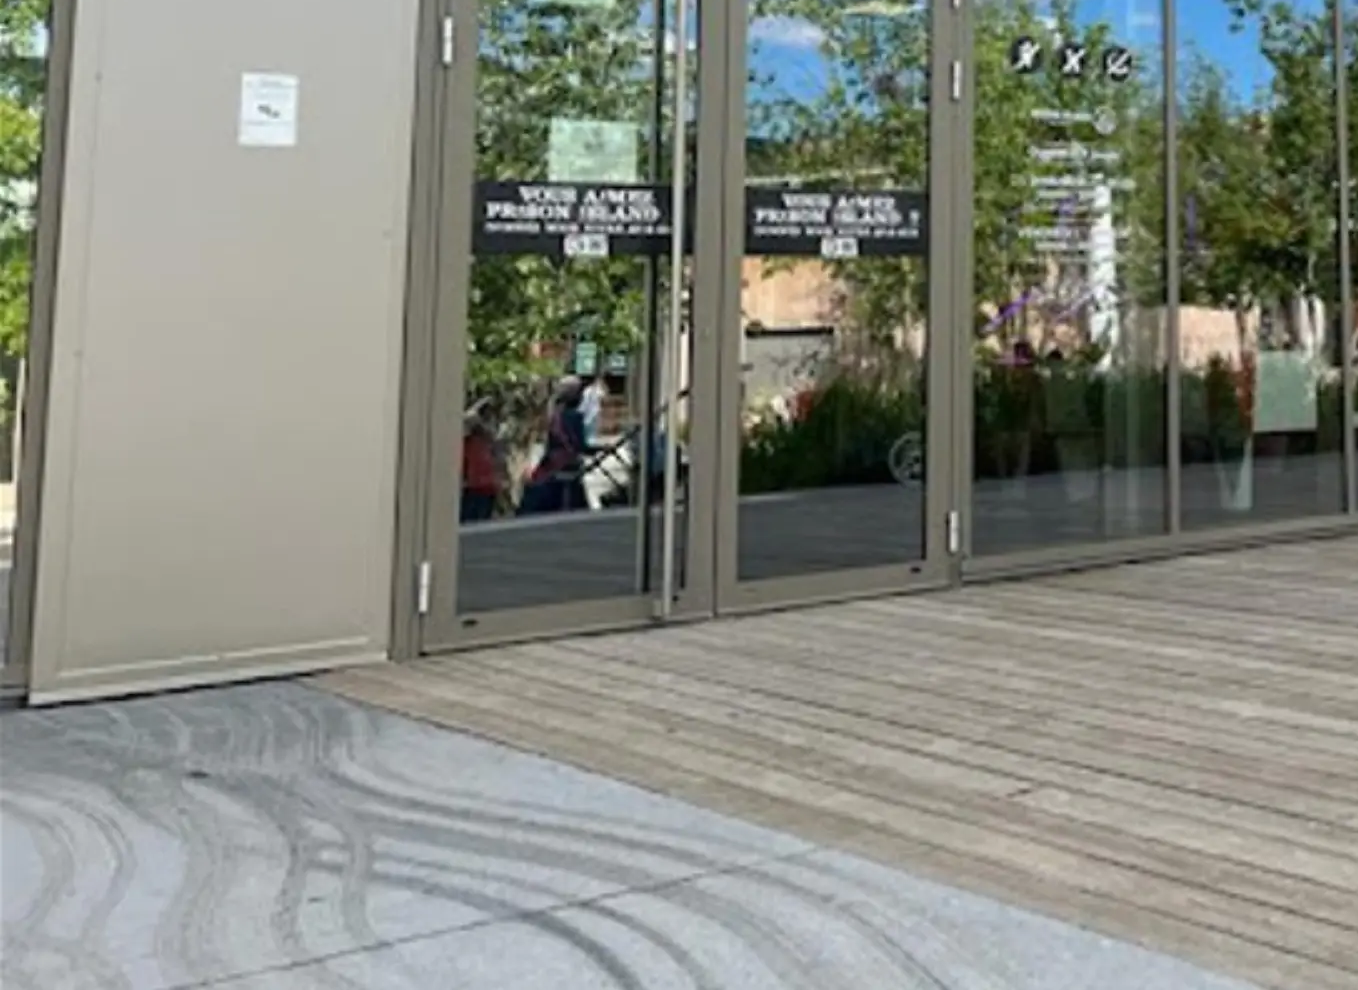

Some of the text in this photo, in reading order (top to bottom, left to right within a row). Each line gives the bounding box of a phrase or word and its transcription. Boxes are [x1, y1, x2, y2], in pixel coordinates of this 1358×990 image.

[518, 186, 578, 204] VOUS
[485, 201, 661, 223] PRISON ISLAND
